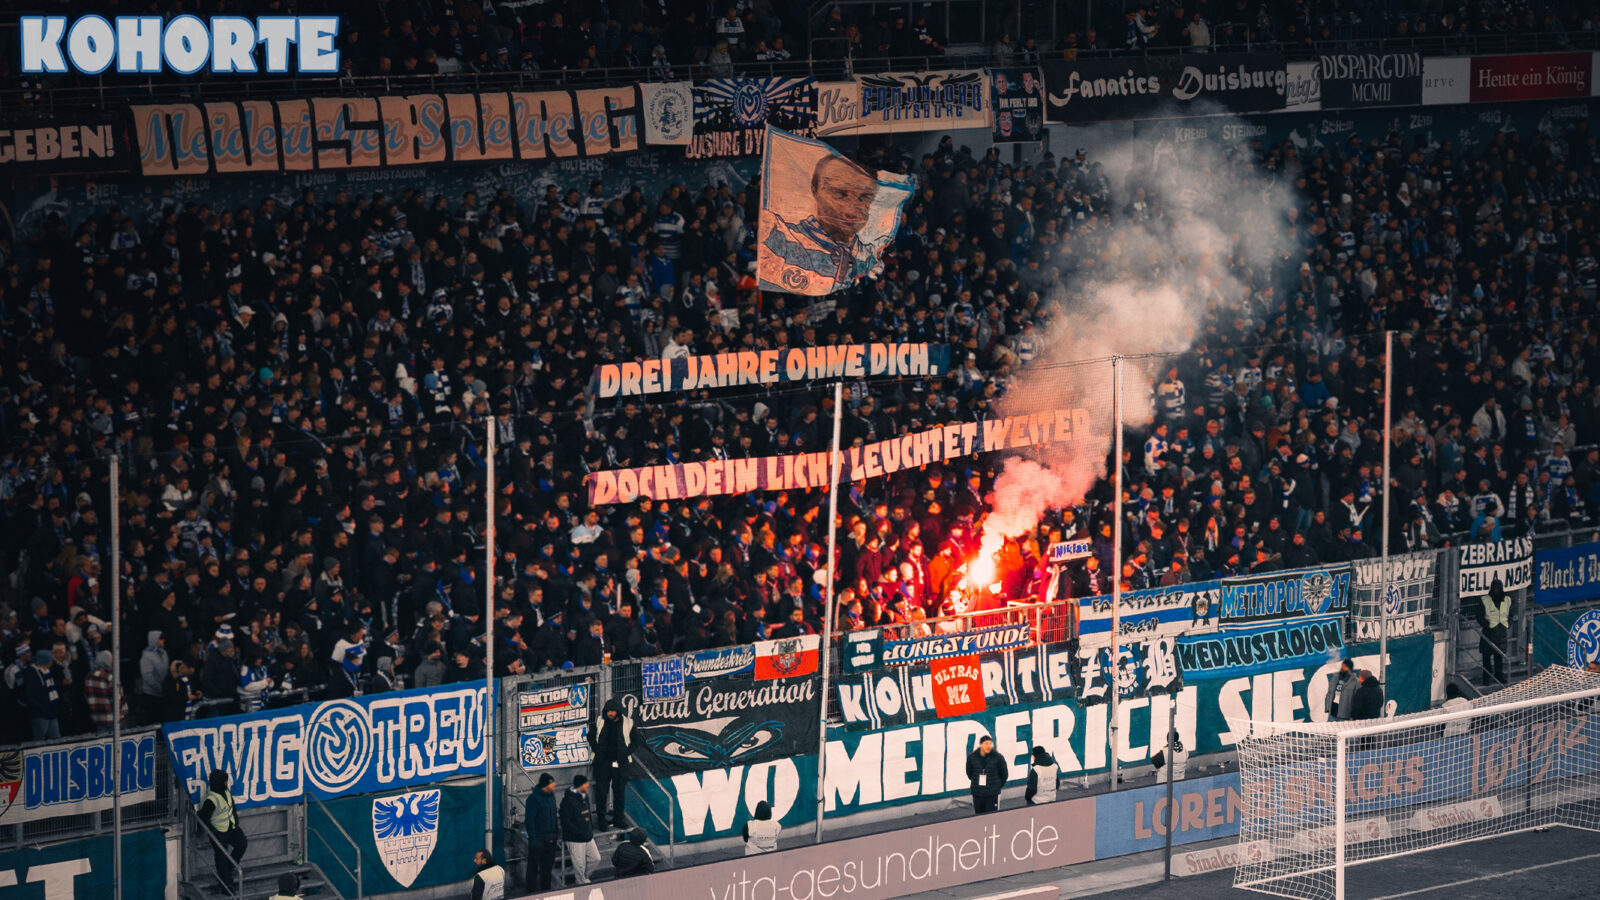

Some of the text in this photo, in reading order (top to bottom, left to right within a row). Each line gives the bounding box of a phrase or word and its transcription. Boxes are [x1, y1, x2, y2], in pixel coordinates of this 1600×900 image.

[1320, 52, 1422, 80] DISPARGUM
[1478, 65, 1585, 91] Heute ein König
[1049, 64, 1286, 107] Fanatics Duisburg
[1352, 82, 1391, 102] MCMII
[1425, 76, 1455, 89] urve
[818, 88, 859, 126] Kön
[130, 84, 638, 175] DUISBURG
[347, 168, 426, 182] WEDAUSTADION
[600, 342, 938, 397] DREI JAHRE OHNE DICH.
[593, 464, 679, 505] DOCH
[682, 457, 758, 497] DEIN
[851, 422, 977, 481] LEUCHTET
[1460, 536, 1533, 566] ZEBRAFANS
[1540, 560, 1575, 590] Block
[1330, 572, 1351, 608] 47
[1176, 619, 1345, 672] WEDAUSTADION
[642, 660, 682, 673] SEKTION
[685, 649, 755, 677] Freundeskreis
[934, 664, 979, 686] ULTRAS
[642, 671, 683, 686] STADION
[838, 651, 1072, 722] KOHRTE
[520, 688, 569, 705] SEKTION
[696, 678, 815, 718] Generation
[946, 684, 971, 706] MZ
[521, 707, 587, 727] LINKSRHEIN
[168, 686, 489, 812] EWIG TREU
[556, 729, 587, 746] SEK.
[556, 744, 589, 763] SÜD
[671, 757, 799, 837] WO
[822, 686, 1198, 812] MEIDERICH
[25, 735, 156, 810] DUISBURG
[1427, 806, 1476, 829] Sinalco
[710, 817, 1059, 900] vita-gesundheit.de
[1185, 848, 1240, 874] Sinalco
